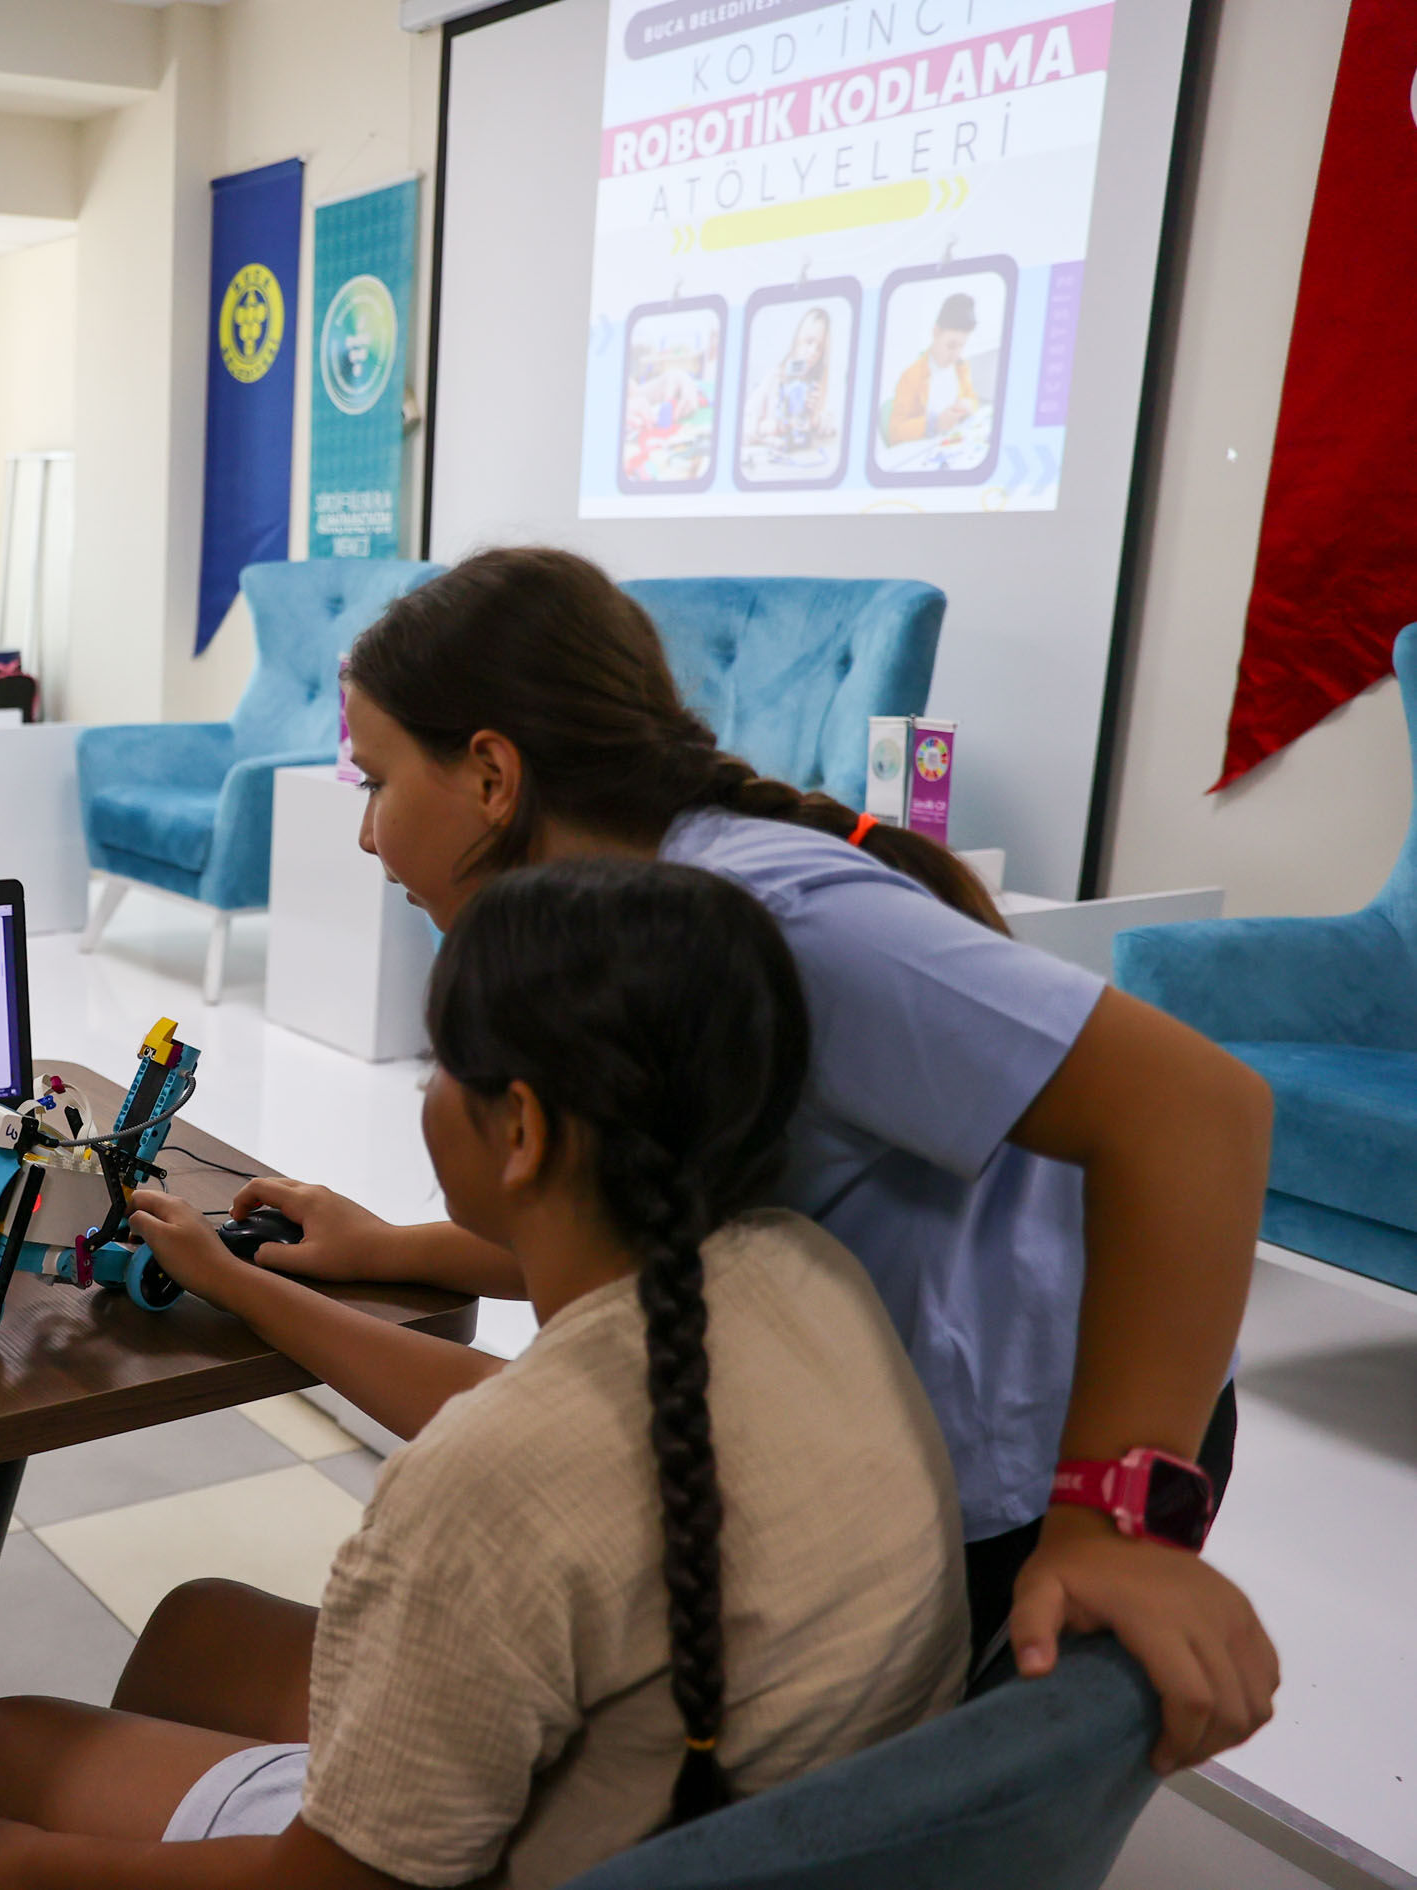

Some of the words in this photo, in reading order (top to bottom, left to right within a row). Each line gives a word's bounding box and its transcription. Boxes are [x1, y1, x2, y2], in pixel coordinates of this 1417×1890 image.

[643, 17, 686, 43] BUCA
[612, 88, 798, 176] ROBOTİK
[808, 25, 1076, 134] KODLAMA
[648, 102, 1013, 223] ATÖLYELERİ
